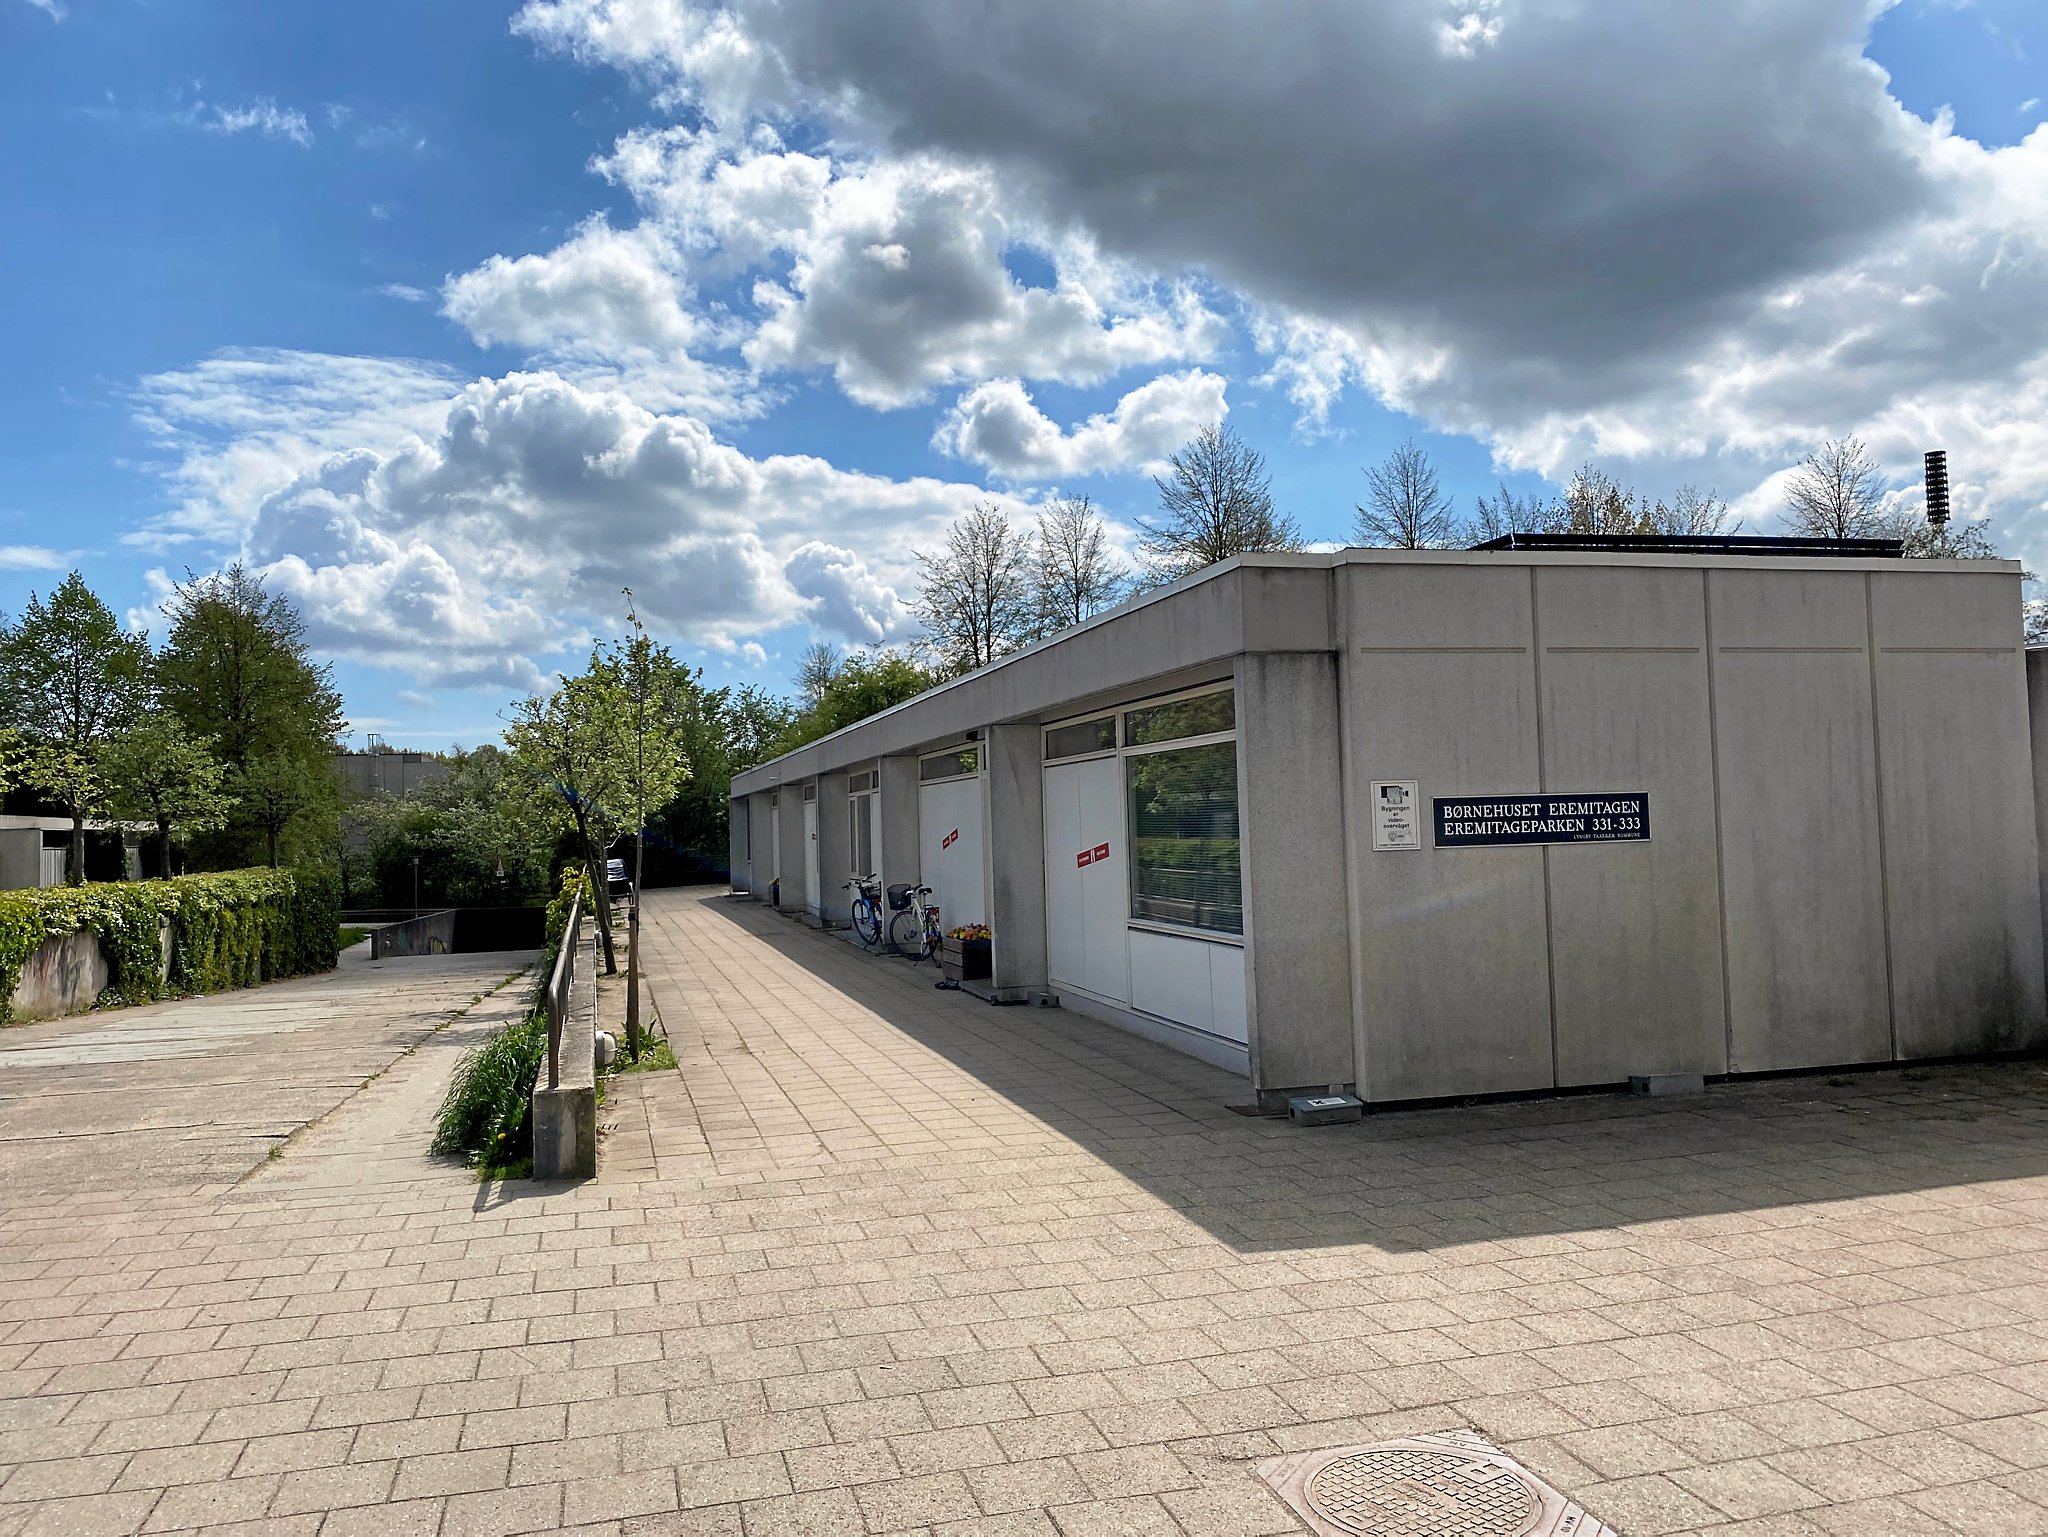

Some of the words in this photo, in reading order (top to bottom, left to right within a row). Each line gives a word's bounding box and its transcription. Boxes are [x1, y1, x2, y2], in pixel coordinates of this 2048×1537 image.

[1381, 805, 1410, 813] Bygningen
[1443, 803, 1542, 819] BØRNEHUSET
[1548, 800, 1640, 816] EREMITAGEN
[1444, 818, 1585, 836] EREMITAGEPARKEN
[1592, 817, 1641, 831] 331-333
